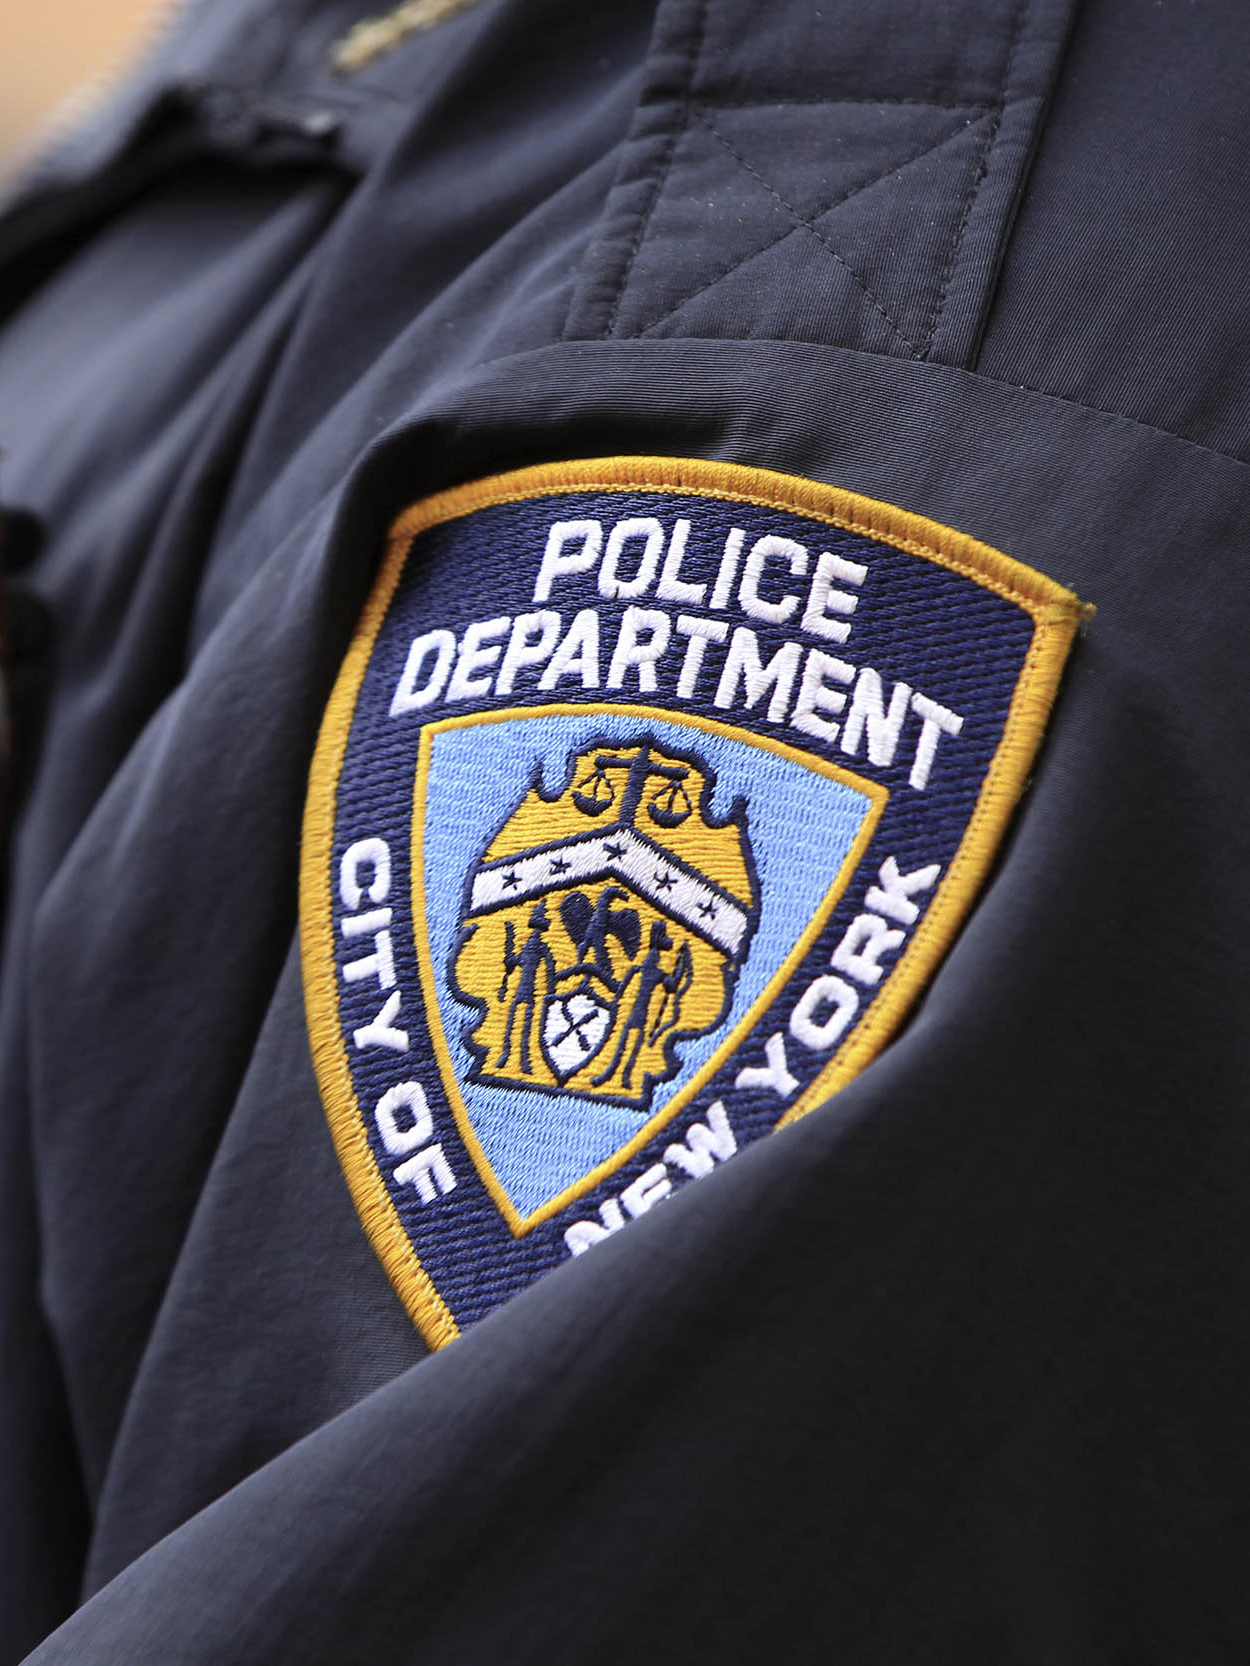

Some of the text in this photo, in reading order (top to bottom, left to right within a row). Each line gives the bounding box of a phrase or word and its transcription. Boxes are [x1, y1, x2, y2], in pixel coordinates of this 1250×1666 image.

[533, 517, 869, 643] POLICE
[390, 606, 964, 790] DEPARTMENT
[340, 837, 457, 1203] CITY OF
[735, 856, 941, 1099] YORK
